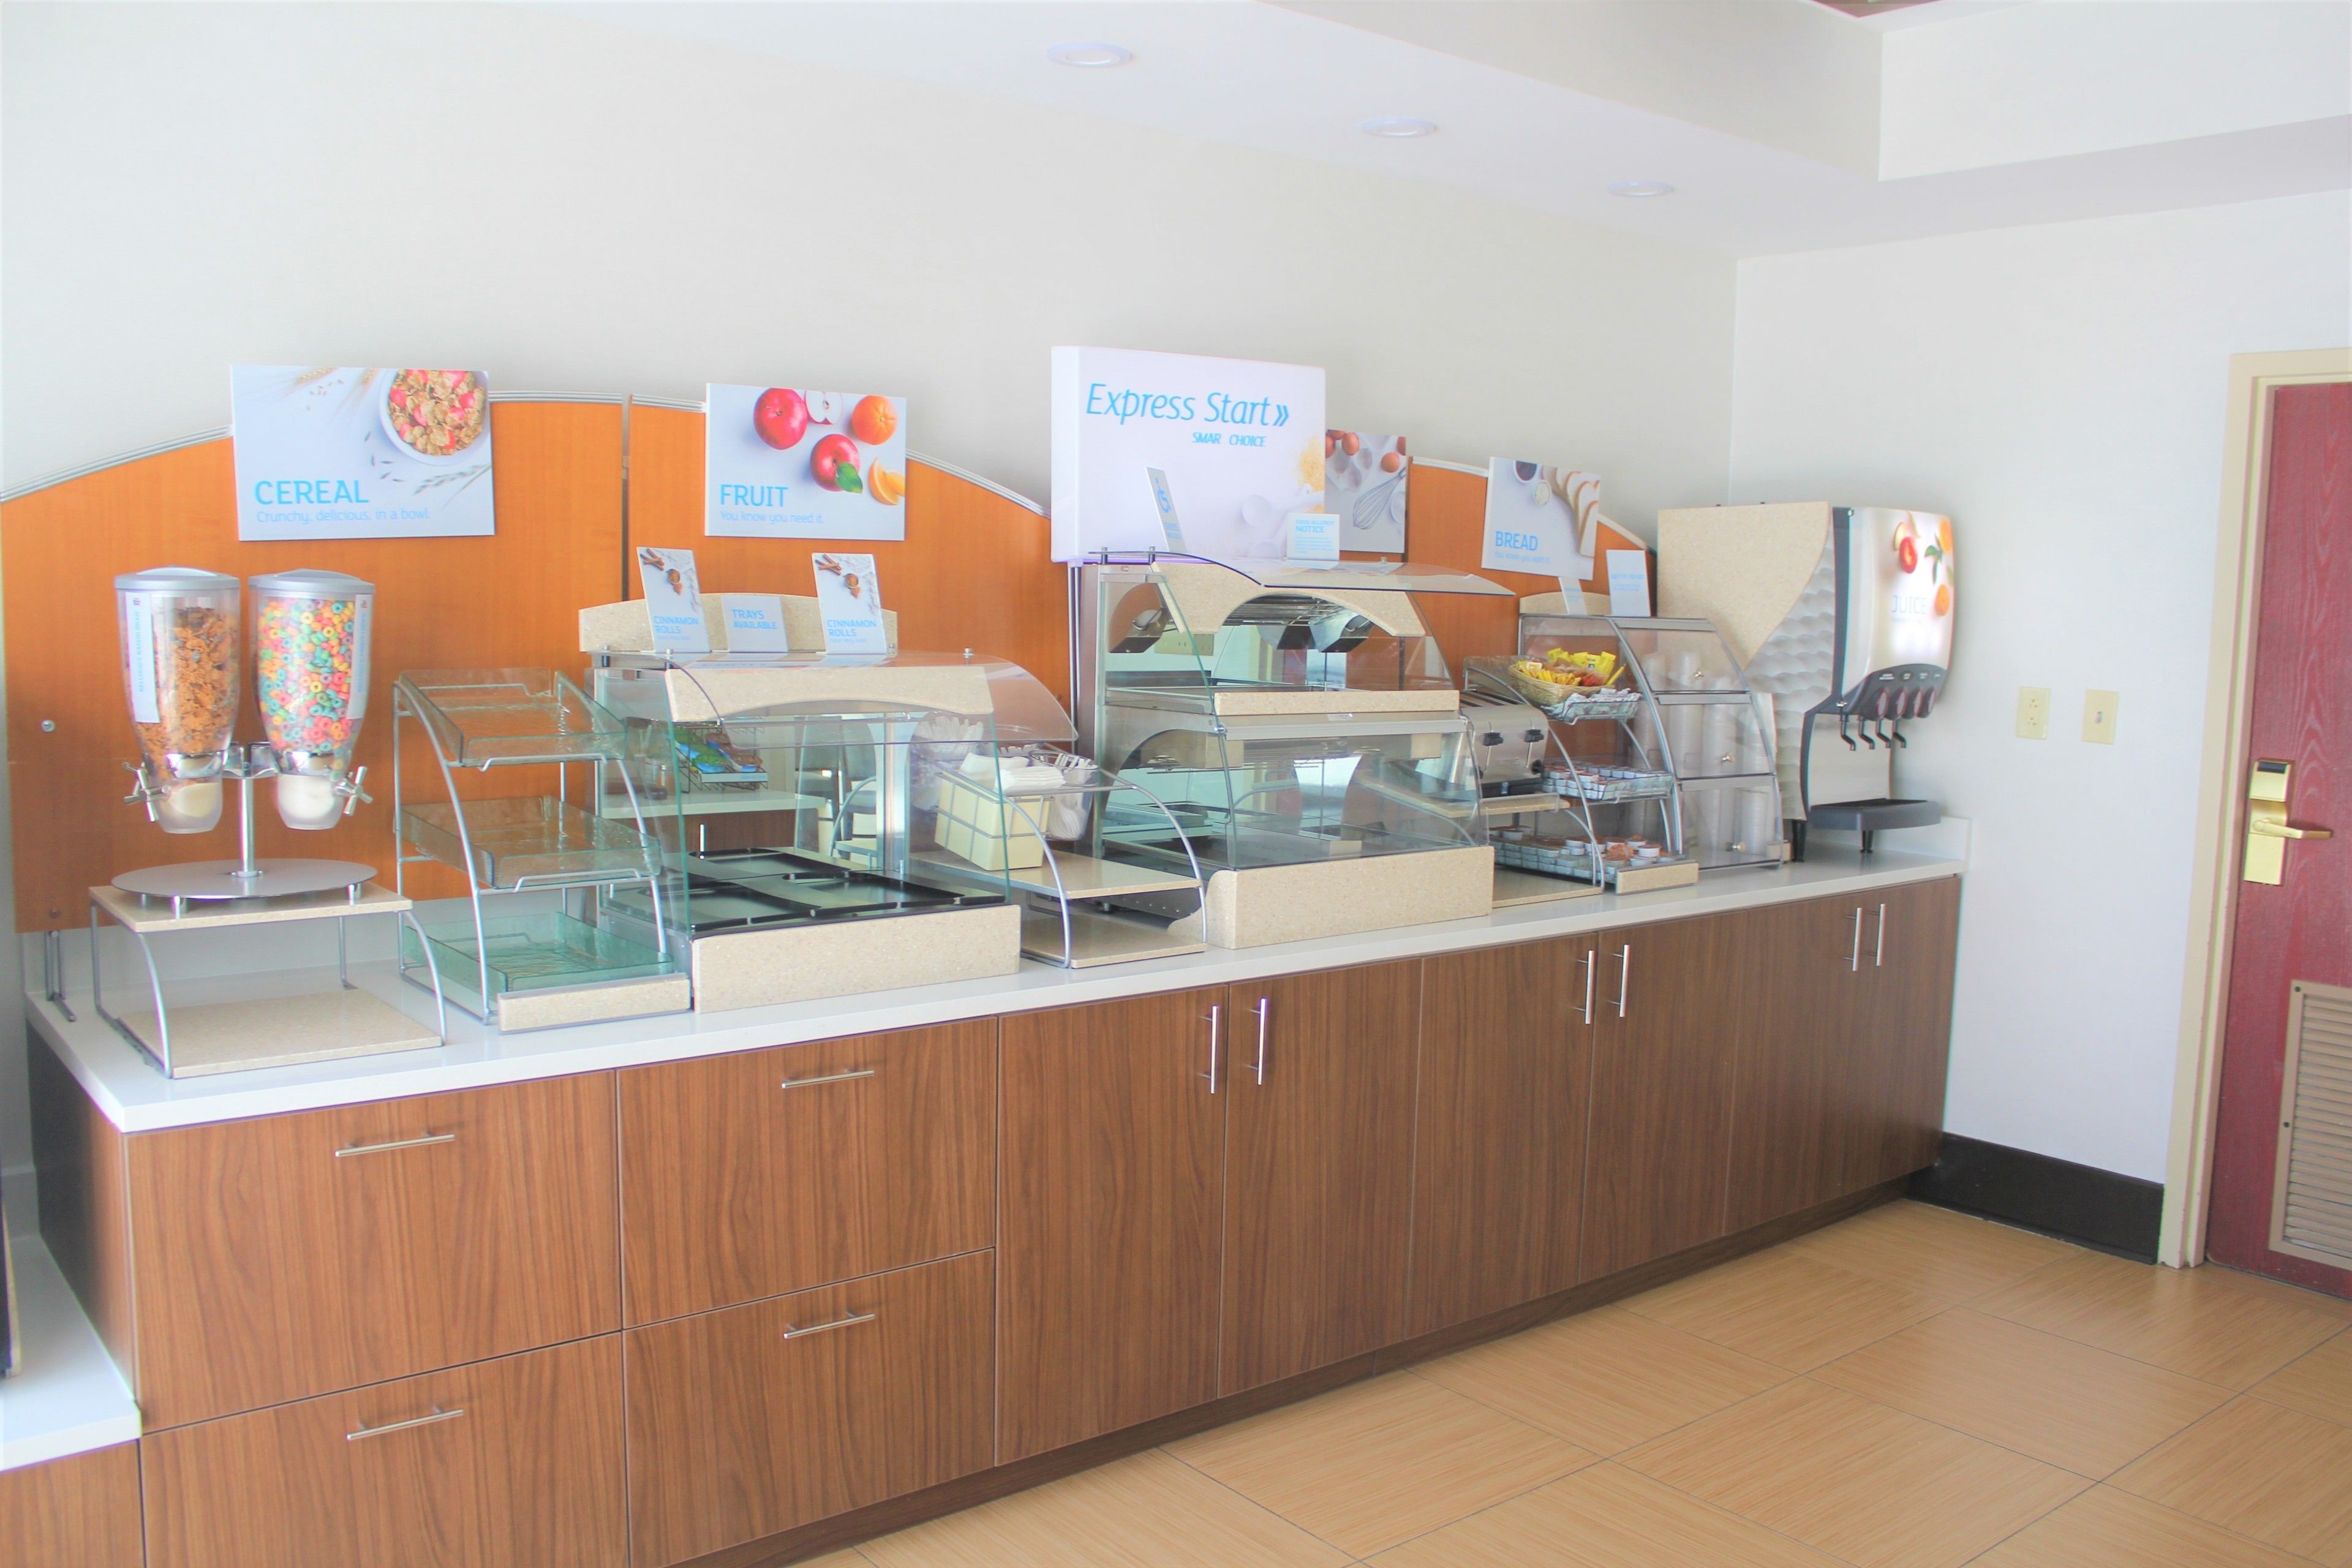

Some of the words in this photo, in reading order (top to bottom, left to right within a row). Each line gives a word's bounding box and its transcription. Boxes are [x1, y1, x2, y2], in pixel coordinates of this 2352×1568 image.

[1085, 382, 1196, 425] Express
[1204, 391, 1272, 427] Start
[1191, 432, 1222, 445] SMAR
[1229, 434, 1267, 448] CHOICE
[254, 480, 370, 505] CEREAL
[720, 484, 788, 507] FRUIT
[375, 508, 386, 520] in
[391, 510, 398, 520] a
[720, 510, 738, 521] You
[741, 510, 766, 521] know
[769, 514, 787, 525] you
[790, 512, 813, 523] need
[1495, 530, 1539, 551] BREAD
[1891, 595, 1927, 615] JUICE
[654, 616, 698, 625] CINNAMON
[731, 609, 765, 620] TRAYS
[655, 625, 681, 634] ROLLS
[733, 620, 778, 630] AVAILABLE
[827, 619, 877, 628] CINNAMON
[827, 628, 857, 637] ROLLS
